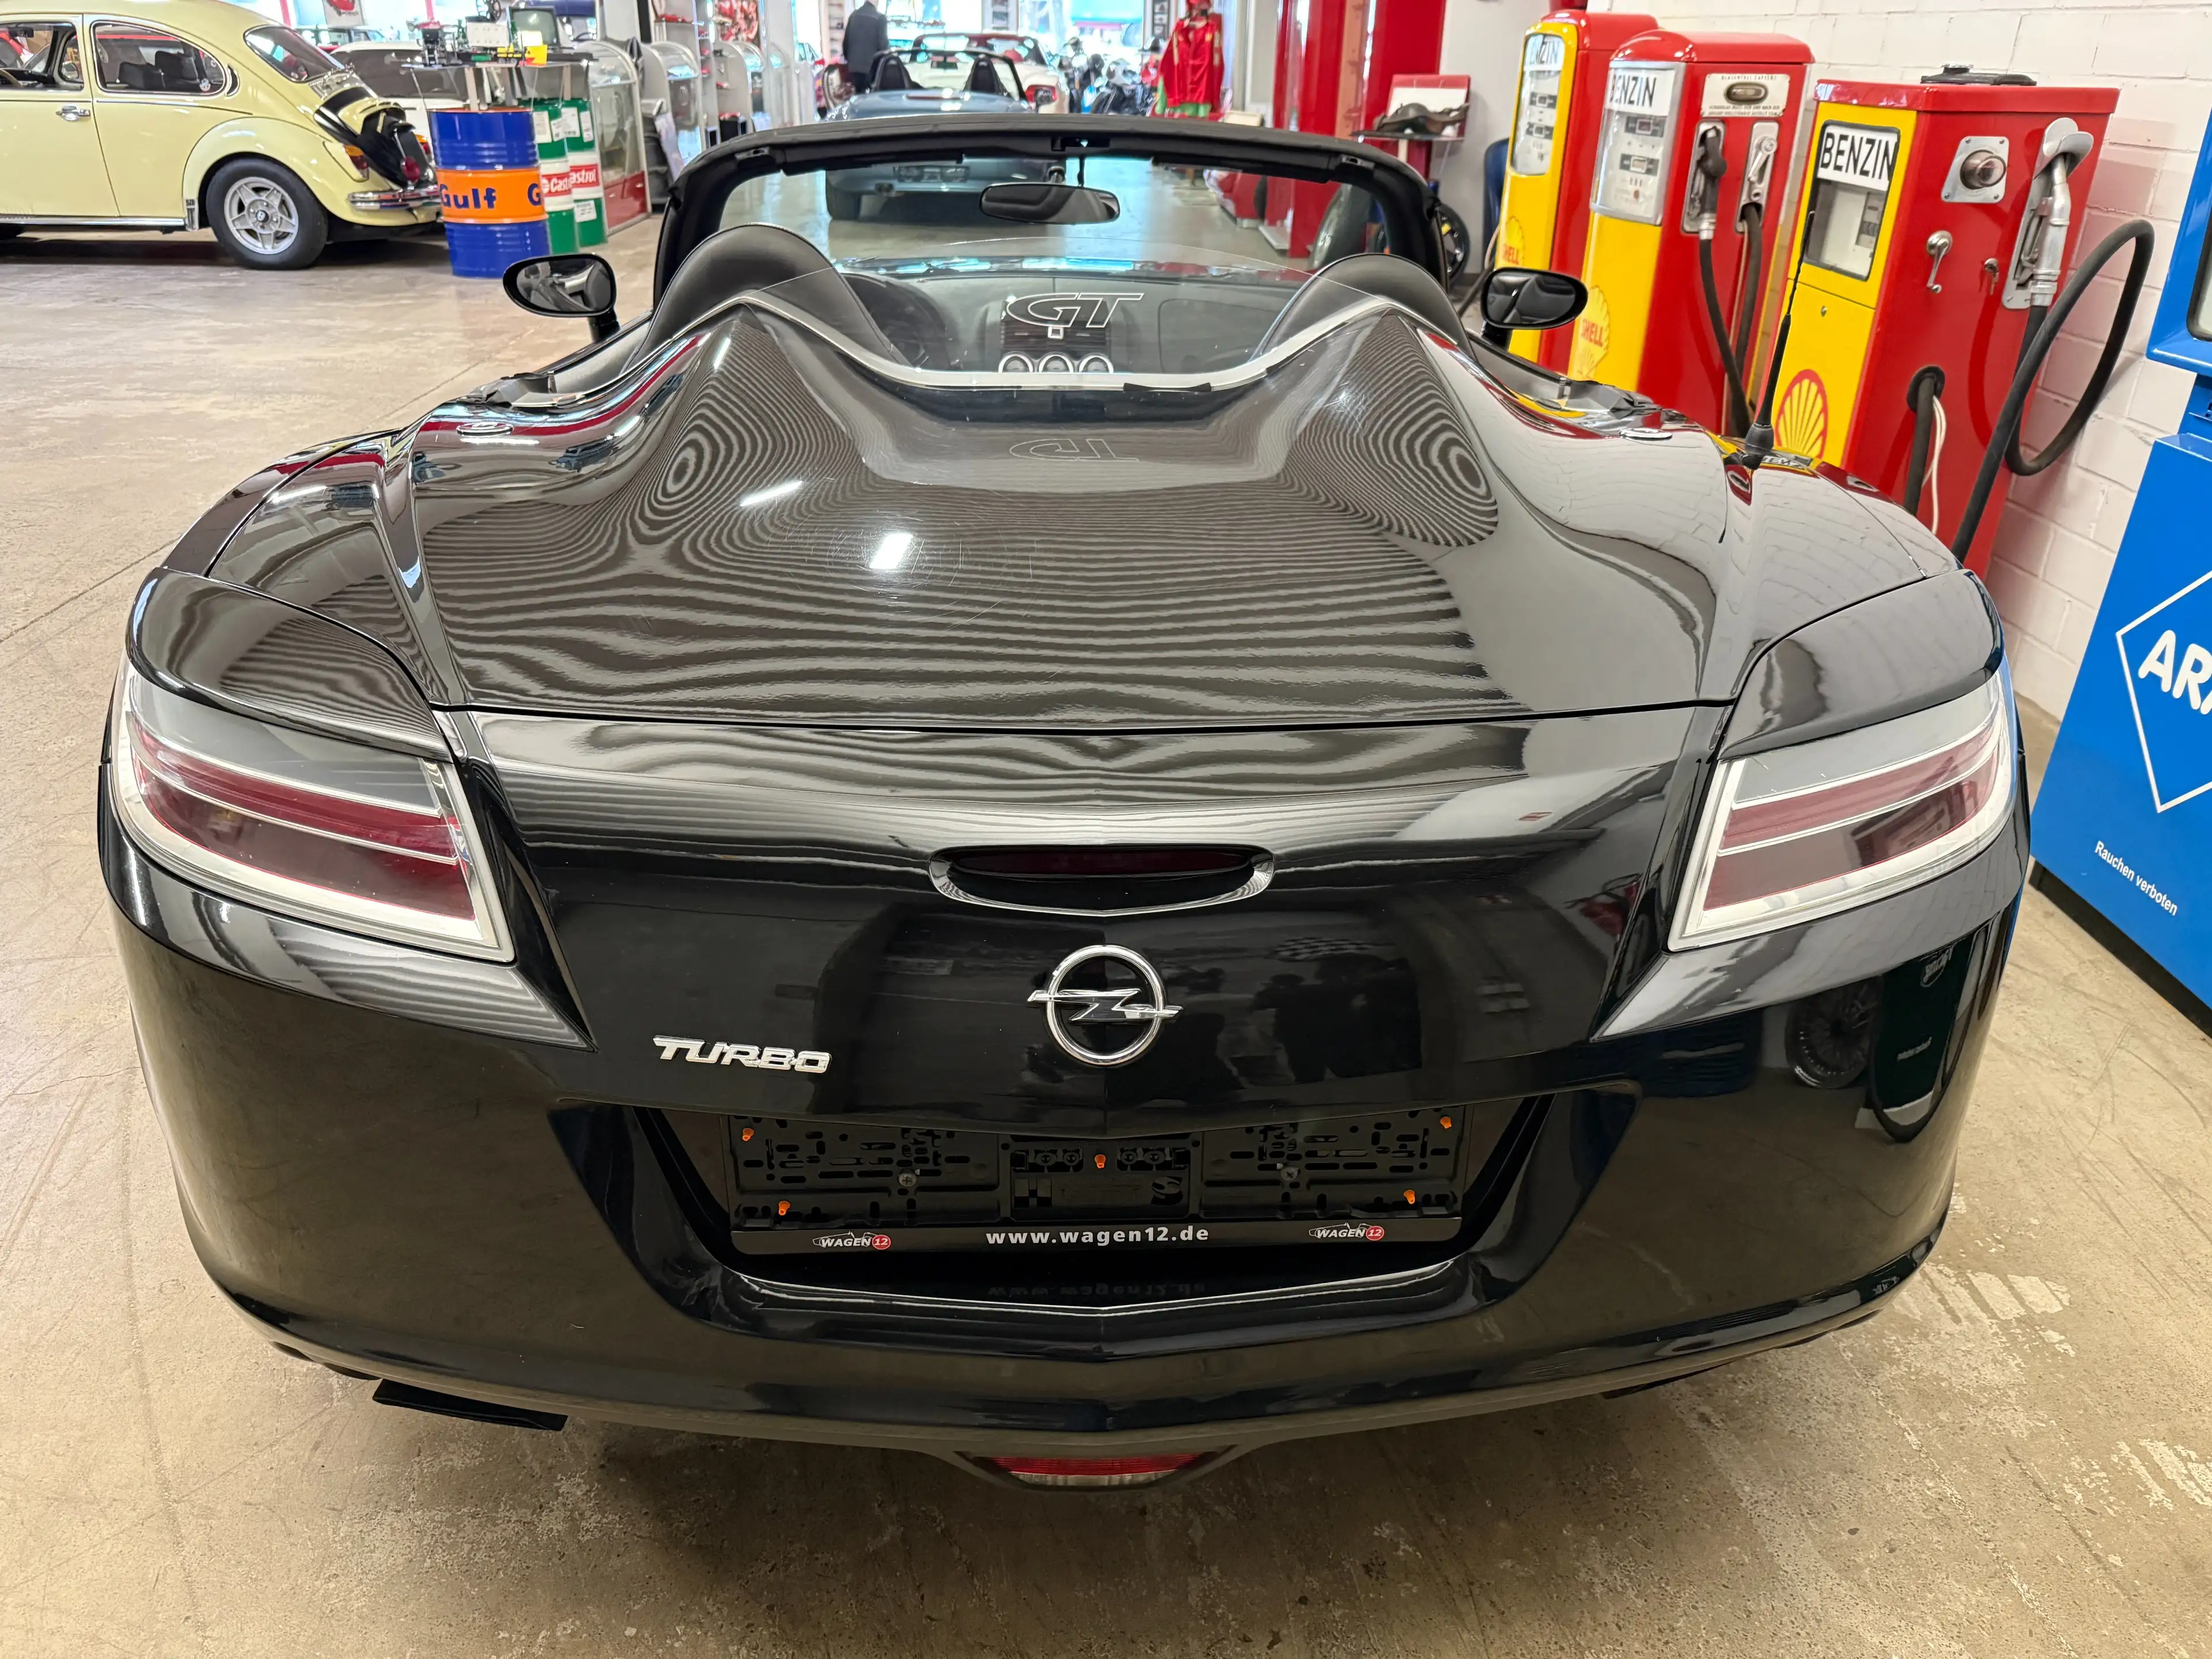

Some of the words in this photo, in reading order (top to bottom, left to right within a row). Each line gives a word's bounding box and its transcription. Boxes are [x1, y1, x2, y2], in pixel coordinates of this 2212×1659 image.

[1820, 132, 1898, 181] BENZIN
[569, 168, 597, 184] astrol
[440, 183, 497, 209] Gulf
[1006, 292, 1145, 328] GT
[1581, 317, 1604, 348] SHELL
[2138, 630, 2212, 715] AR
[2094, 840, 2135, 881] Rauchen
[2135, 875, 2178, 916] verboten
[653, 1035, 832, 1074] TURBO
[821, 1237, 871, 1248] WAGEN
[874, 1237, 888, 1246] 12
[986, 1225, 1209, 1247] www.wagen12.de
[1317, 1228, 1365, 1238] WAGEN
[1368, 1229, 1382, 1237] 12
